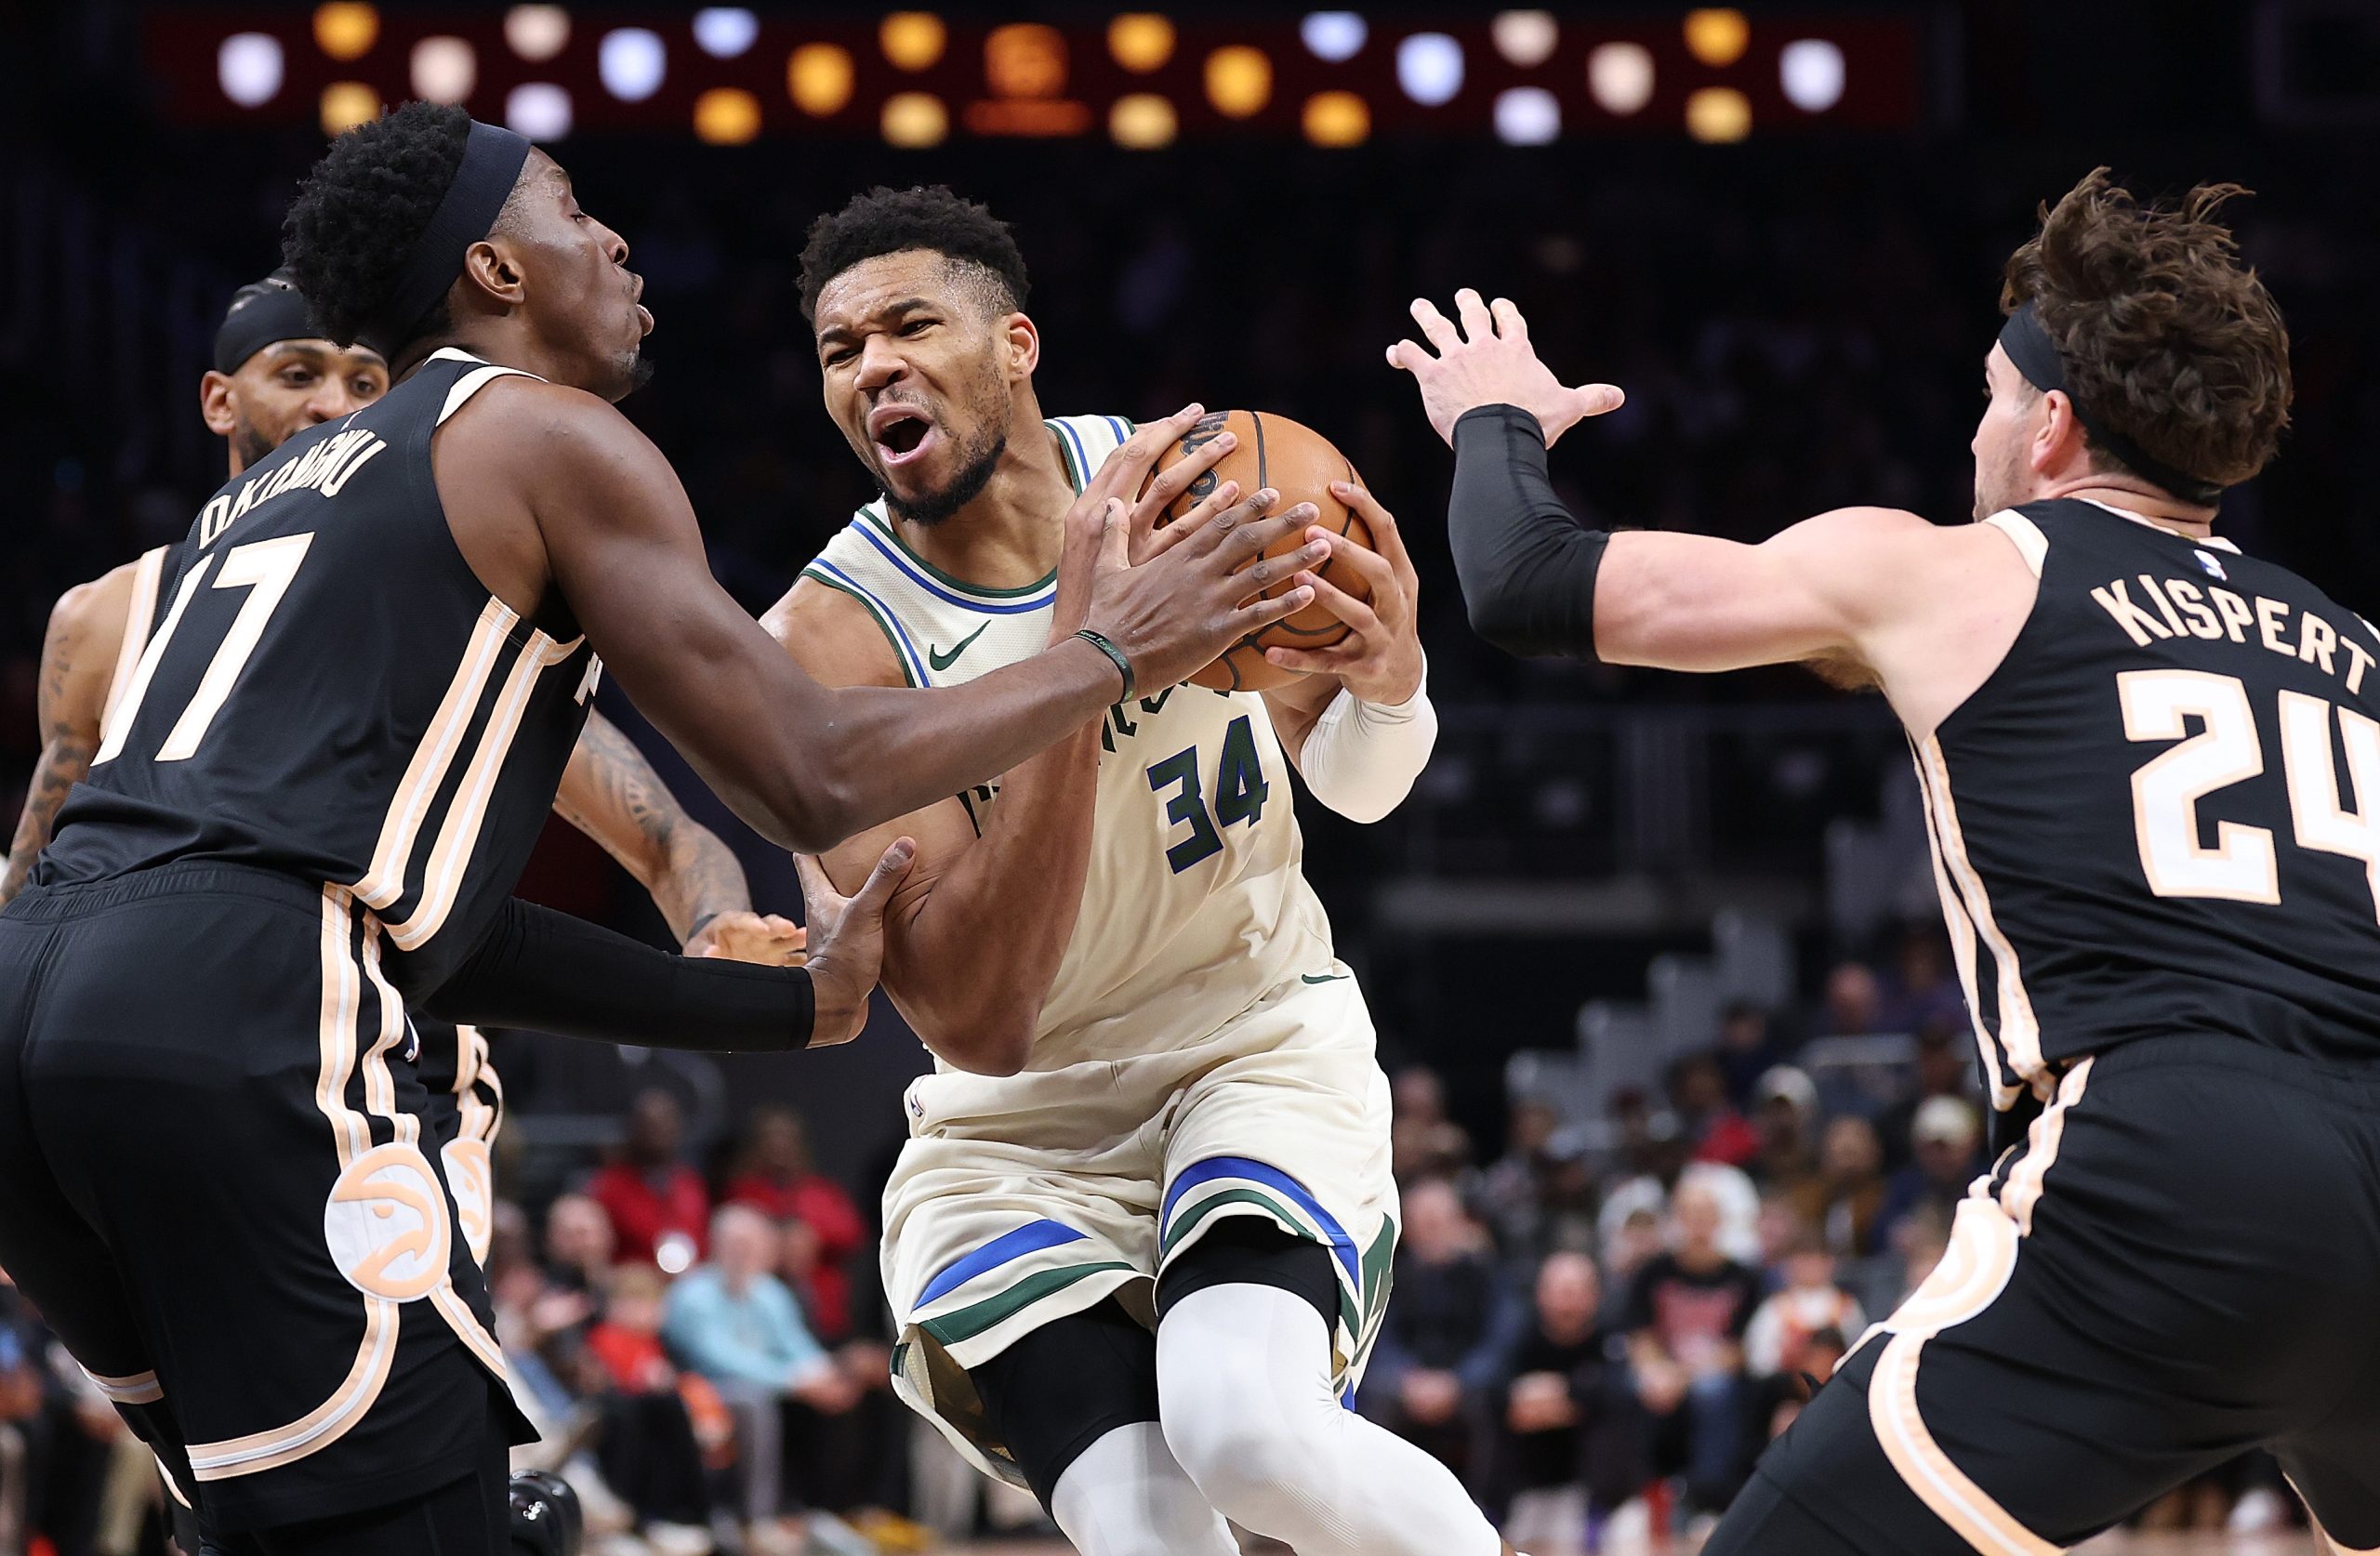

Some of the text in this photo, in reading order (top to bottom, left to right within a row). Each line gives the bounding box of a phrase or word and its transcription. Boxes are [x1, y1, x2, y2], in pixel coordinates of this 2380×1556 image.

[90, 532, 315, 766] 17
[2090, 574, 2376, 695] KISPERT
[1146, 715, 1269, 874] 34
[2115, 668, 2380, 928] 24
